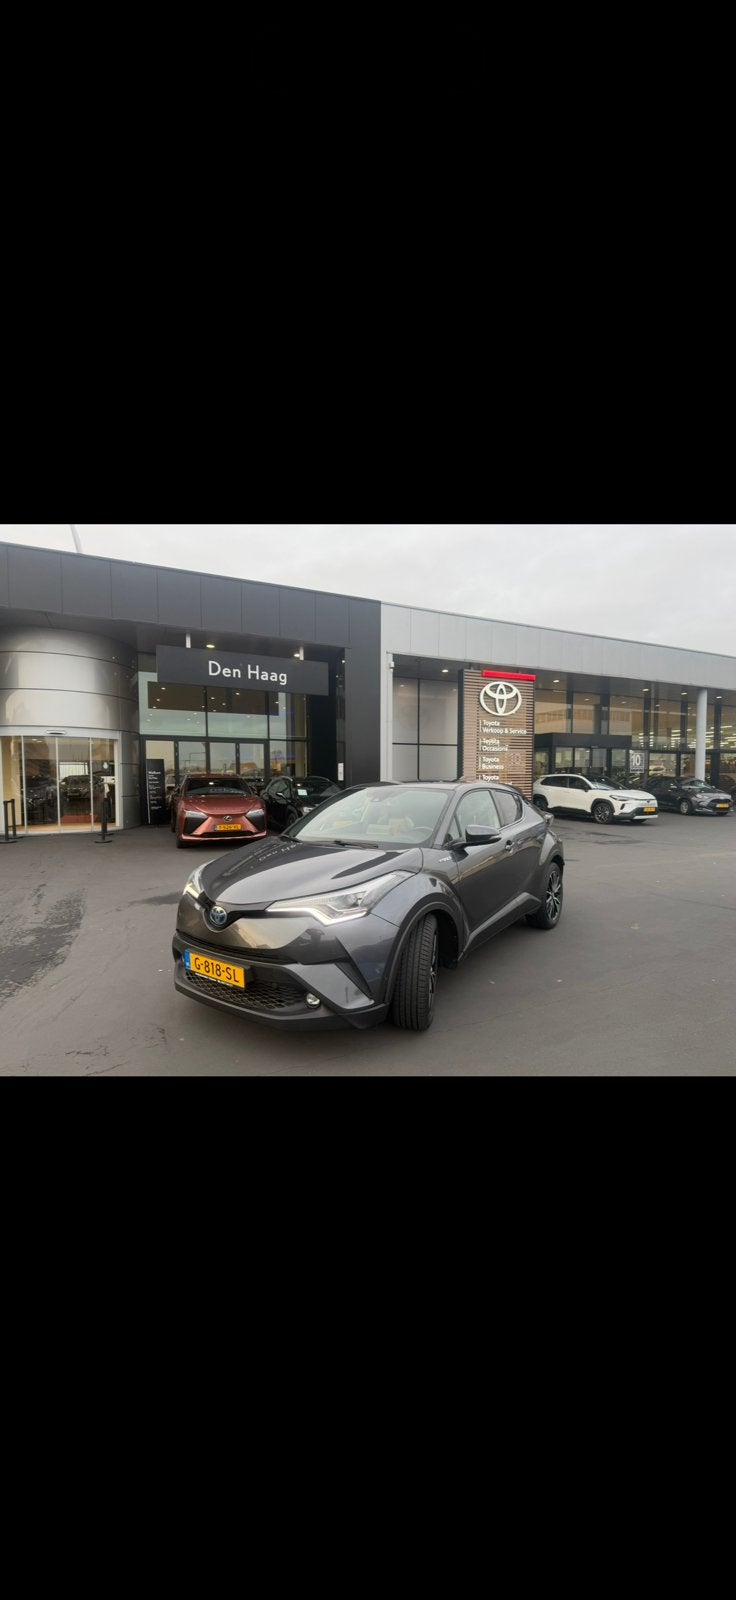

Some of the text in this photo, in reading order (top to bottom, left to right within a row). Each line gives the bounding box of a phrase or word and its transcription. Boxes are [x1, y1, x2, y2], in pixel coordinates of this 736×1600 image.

[208, 660, 287, 685] Den Haag
[482, 774, 500, 782] Toyota
[194, 957, 239, 983] G-818-SL
